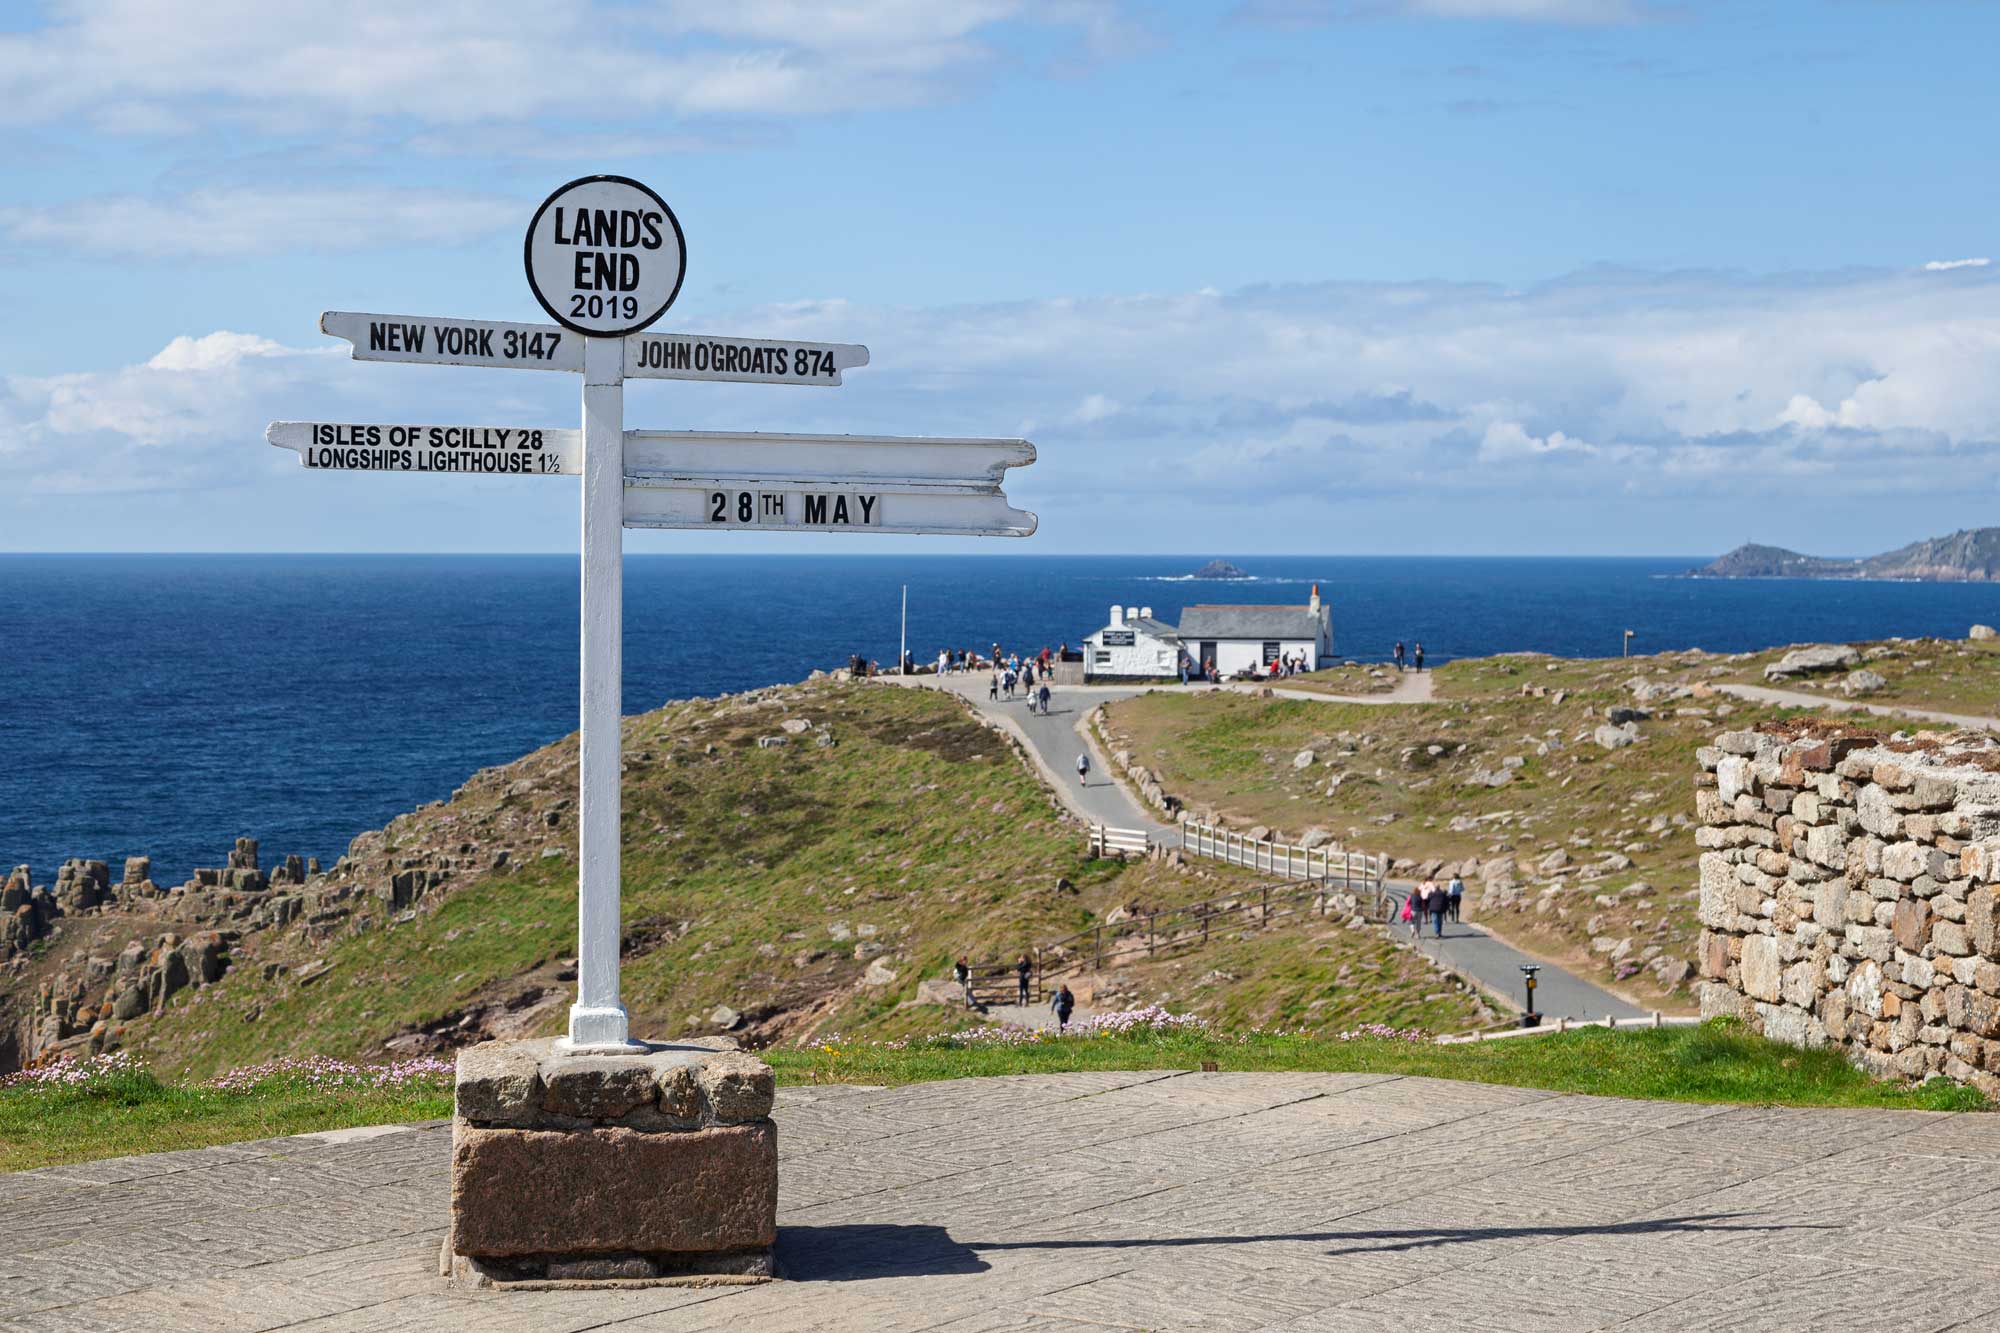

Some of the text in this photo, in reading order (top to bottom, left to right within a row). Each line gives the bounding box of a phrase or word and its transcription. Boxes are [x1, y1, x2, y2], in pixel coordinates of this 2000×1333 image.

[555, 207, 662, 250] LAND'S
[574, 251, 640, 292] END
[570, 294, 638, 319] 2019
[370, 322, 561, 360] NEW YORK 3147
[637, 341, 836, 377] JOHN O'GROATS 874
[313, 424, 543, 450] ISLES OF SCILLY 28
[308, 447, 412, 470] LONGSHIPS
[418, 450, 532, 473] LIGHTHOUSE
[804, 495, 876, 524] MAY
